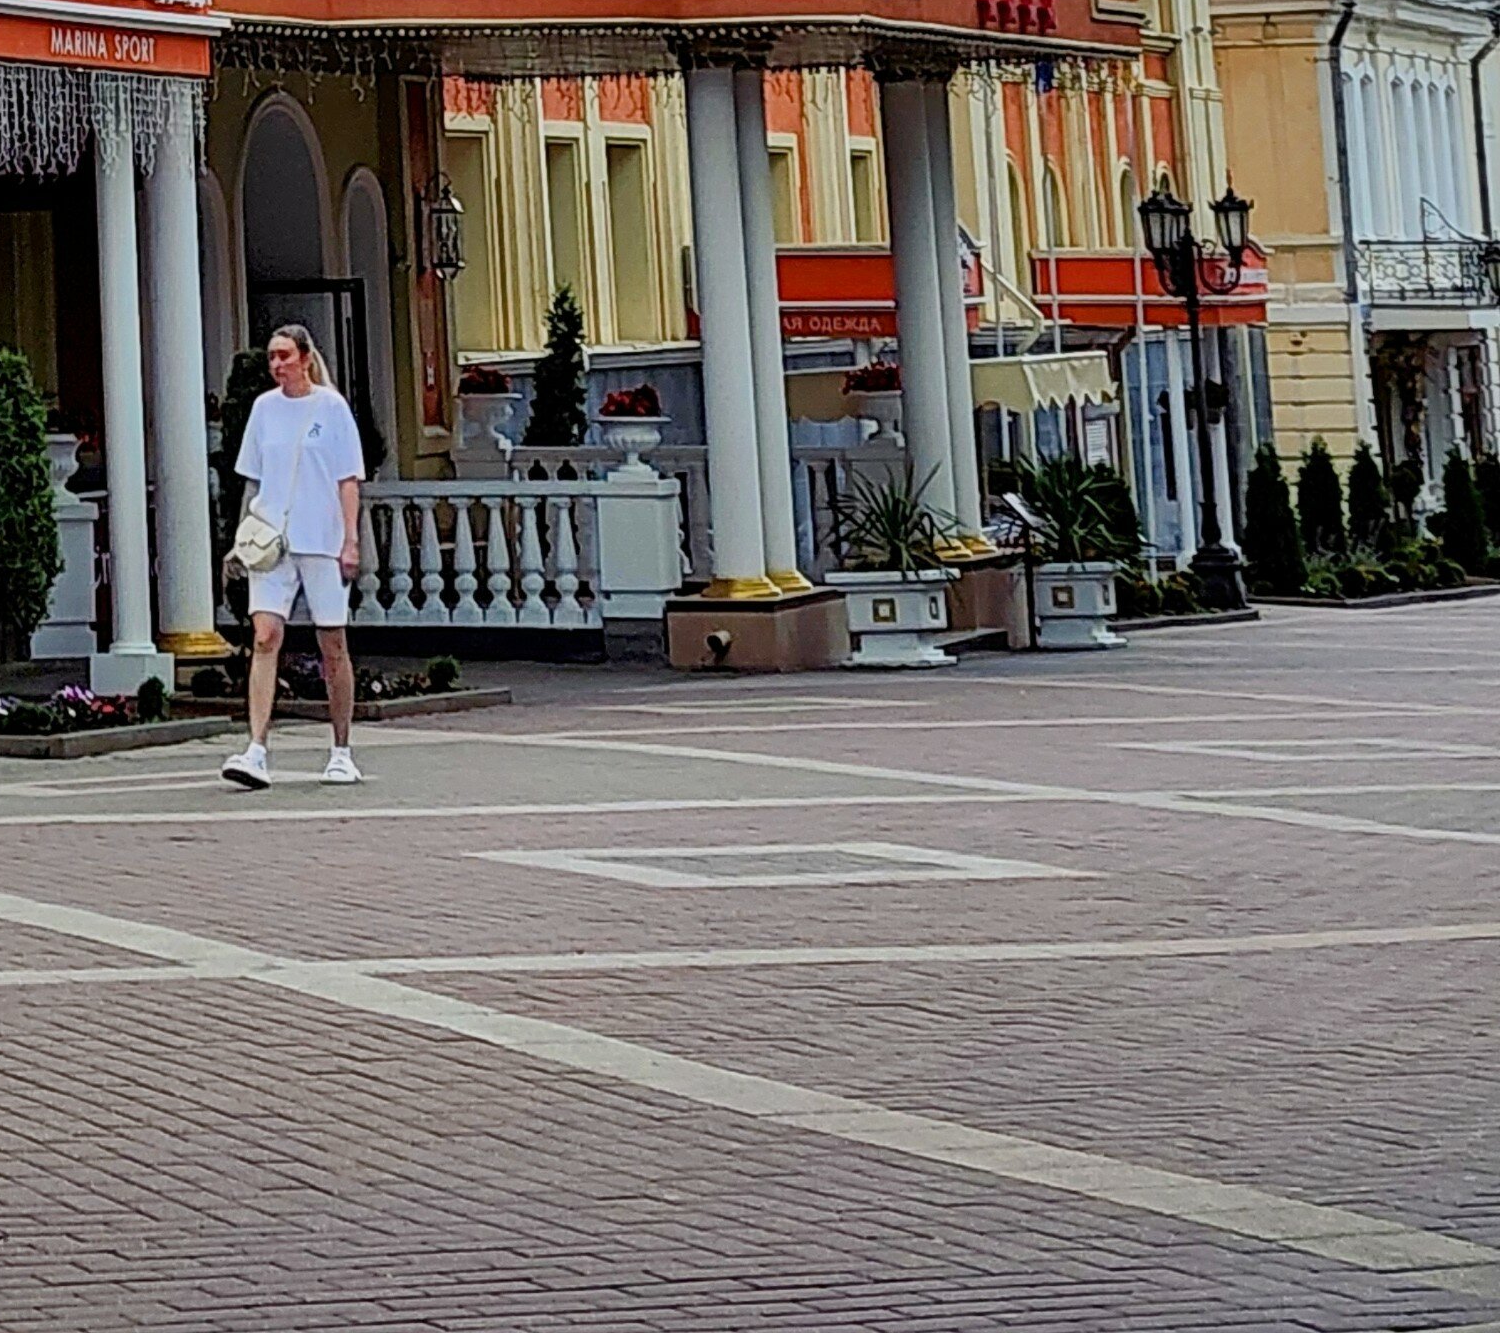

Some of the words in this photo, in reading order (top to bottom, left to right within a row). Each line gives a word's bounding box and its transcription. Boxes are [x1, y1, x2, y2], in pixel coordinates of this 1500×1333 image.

[51, 27, 108, 60] MARINA
[114, 34, 155, 63] SPORT
[809, 317, 882, 332] ОДЕЖДА
